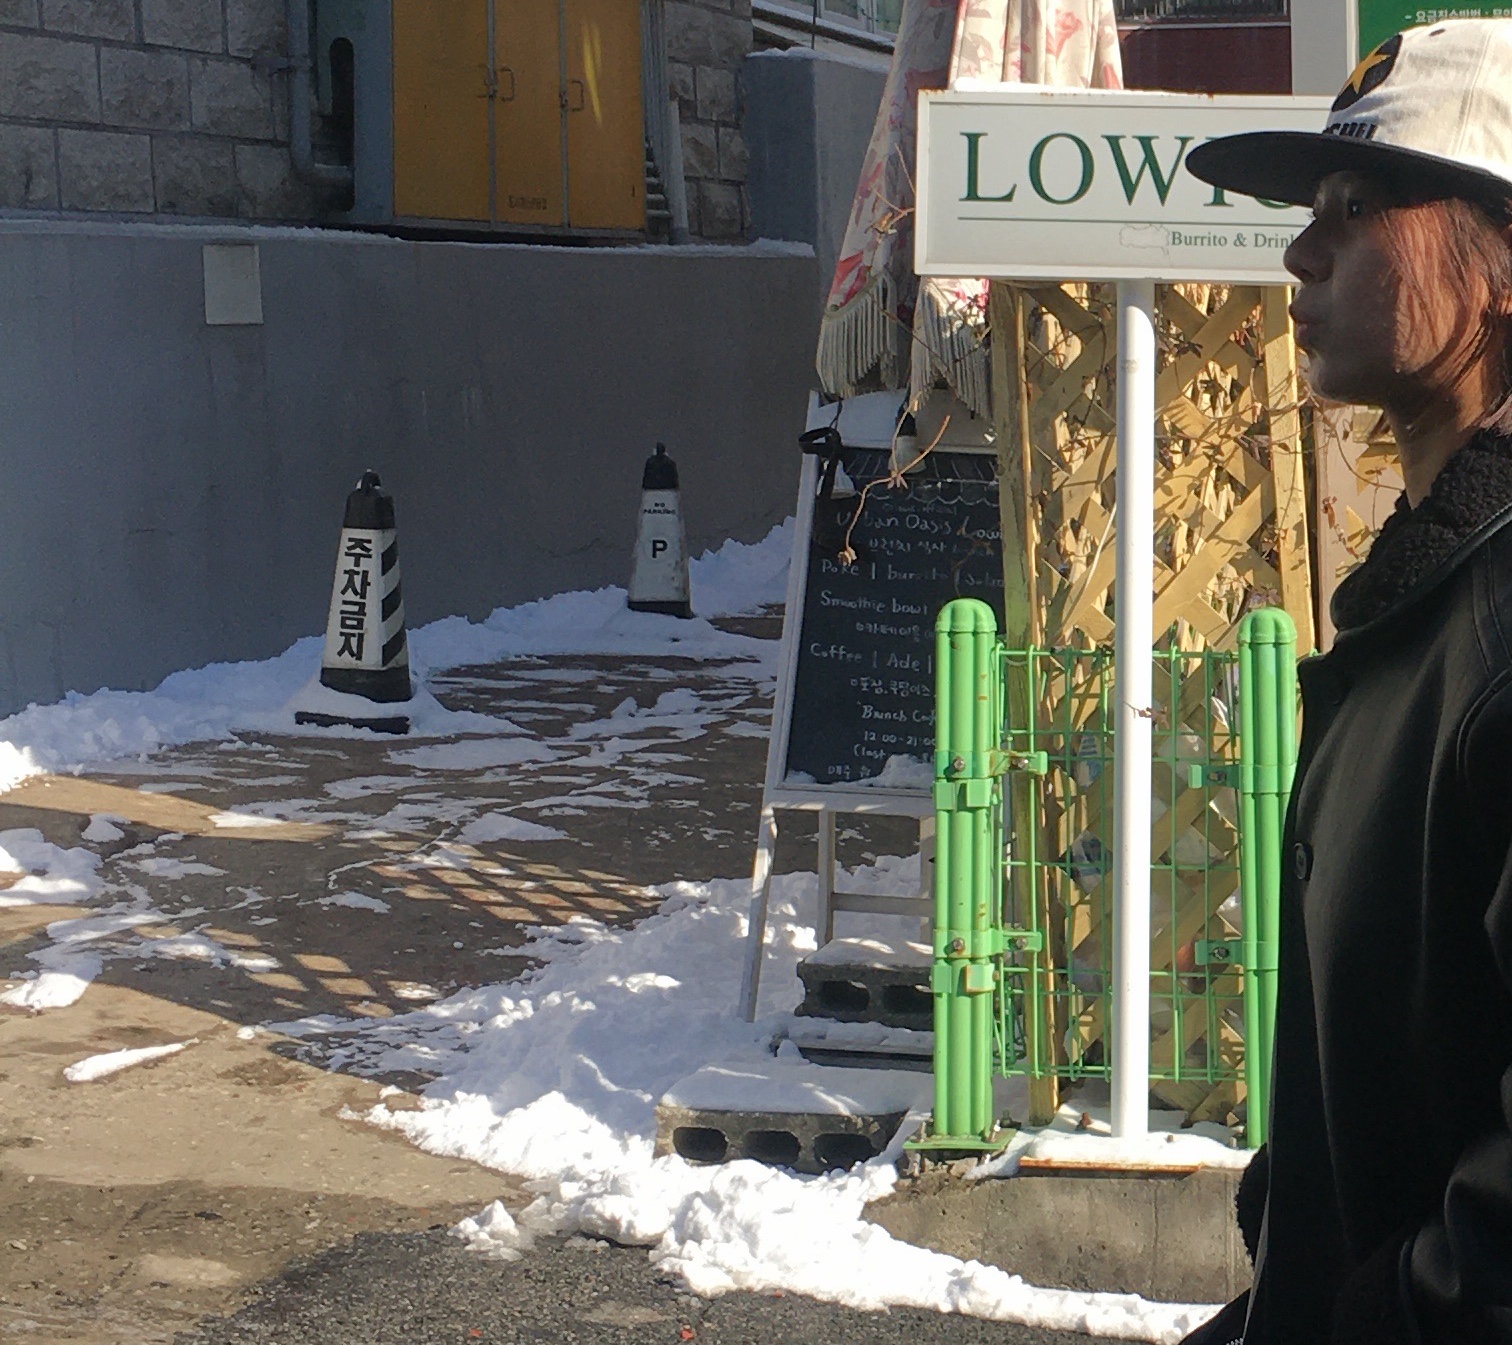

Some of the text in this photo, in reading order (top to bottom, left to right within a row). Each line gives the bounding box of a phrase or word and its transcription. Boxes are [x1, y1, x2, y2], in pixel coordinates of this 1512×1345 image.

[1171, 231, 1228, 247] Burrito
[1233, 232, 1247, 248] &
[652, 539, 669, 559] P
[336, 537, 373, 662] 주차금지
